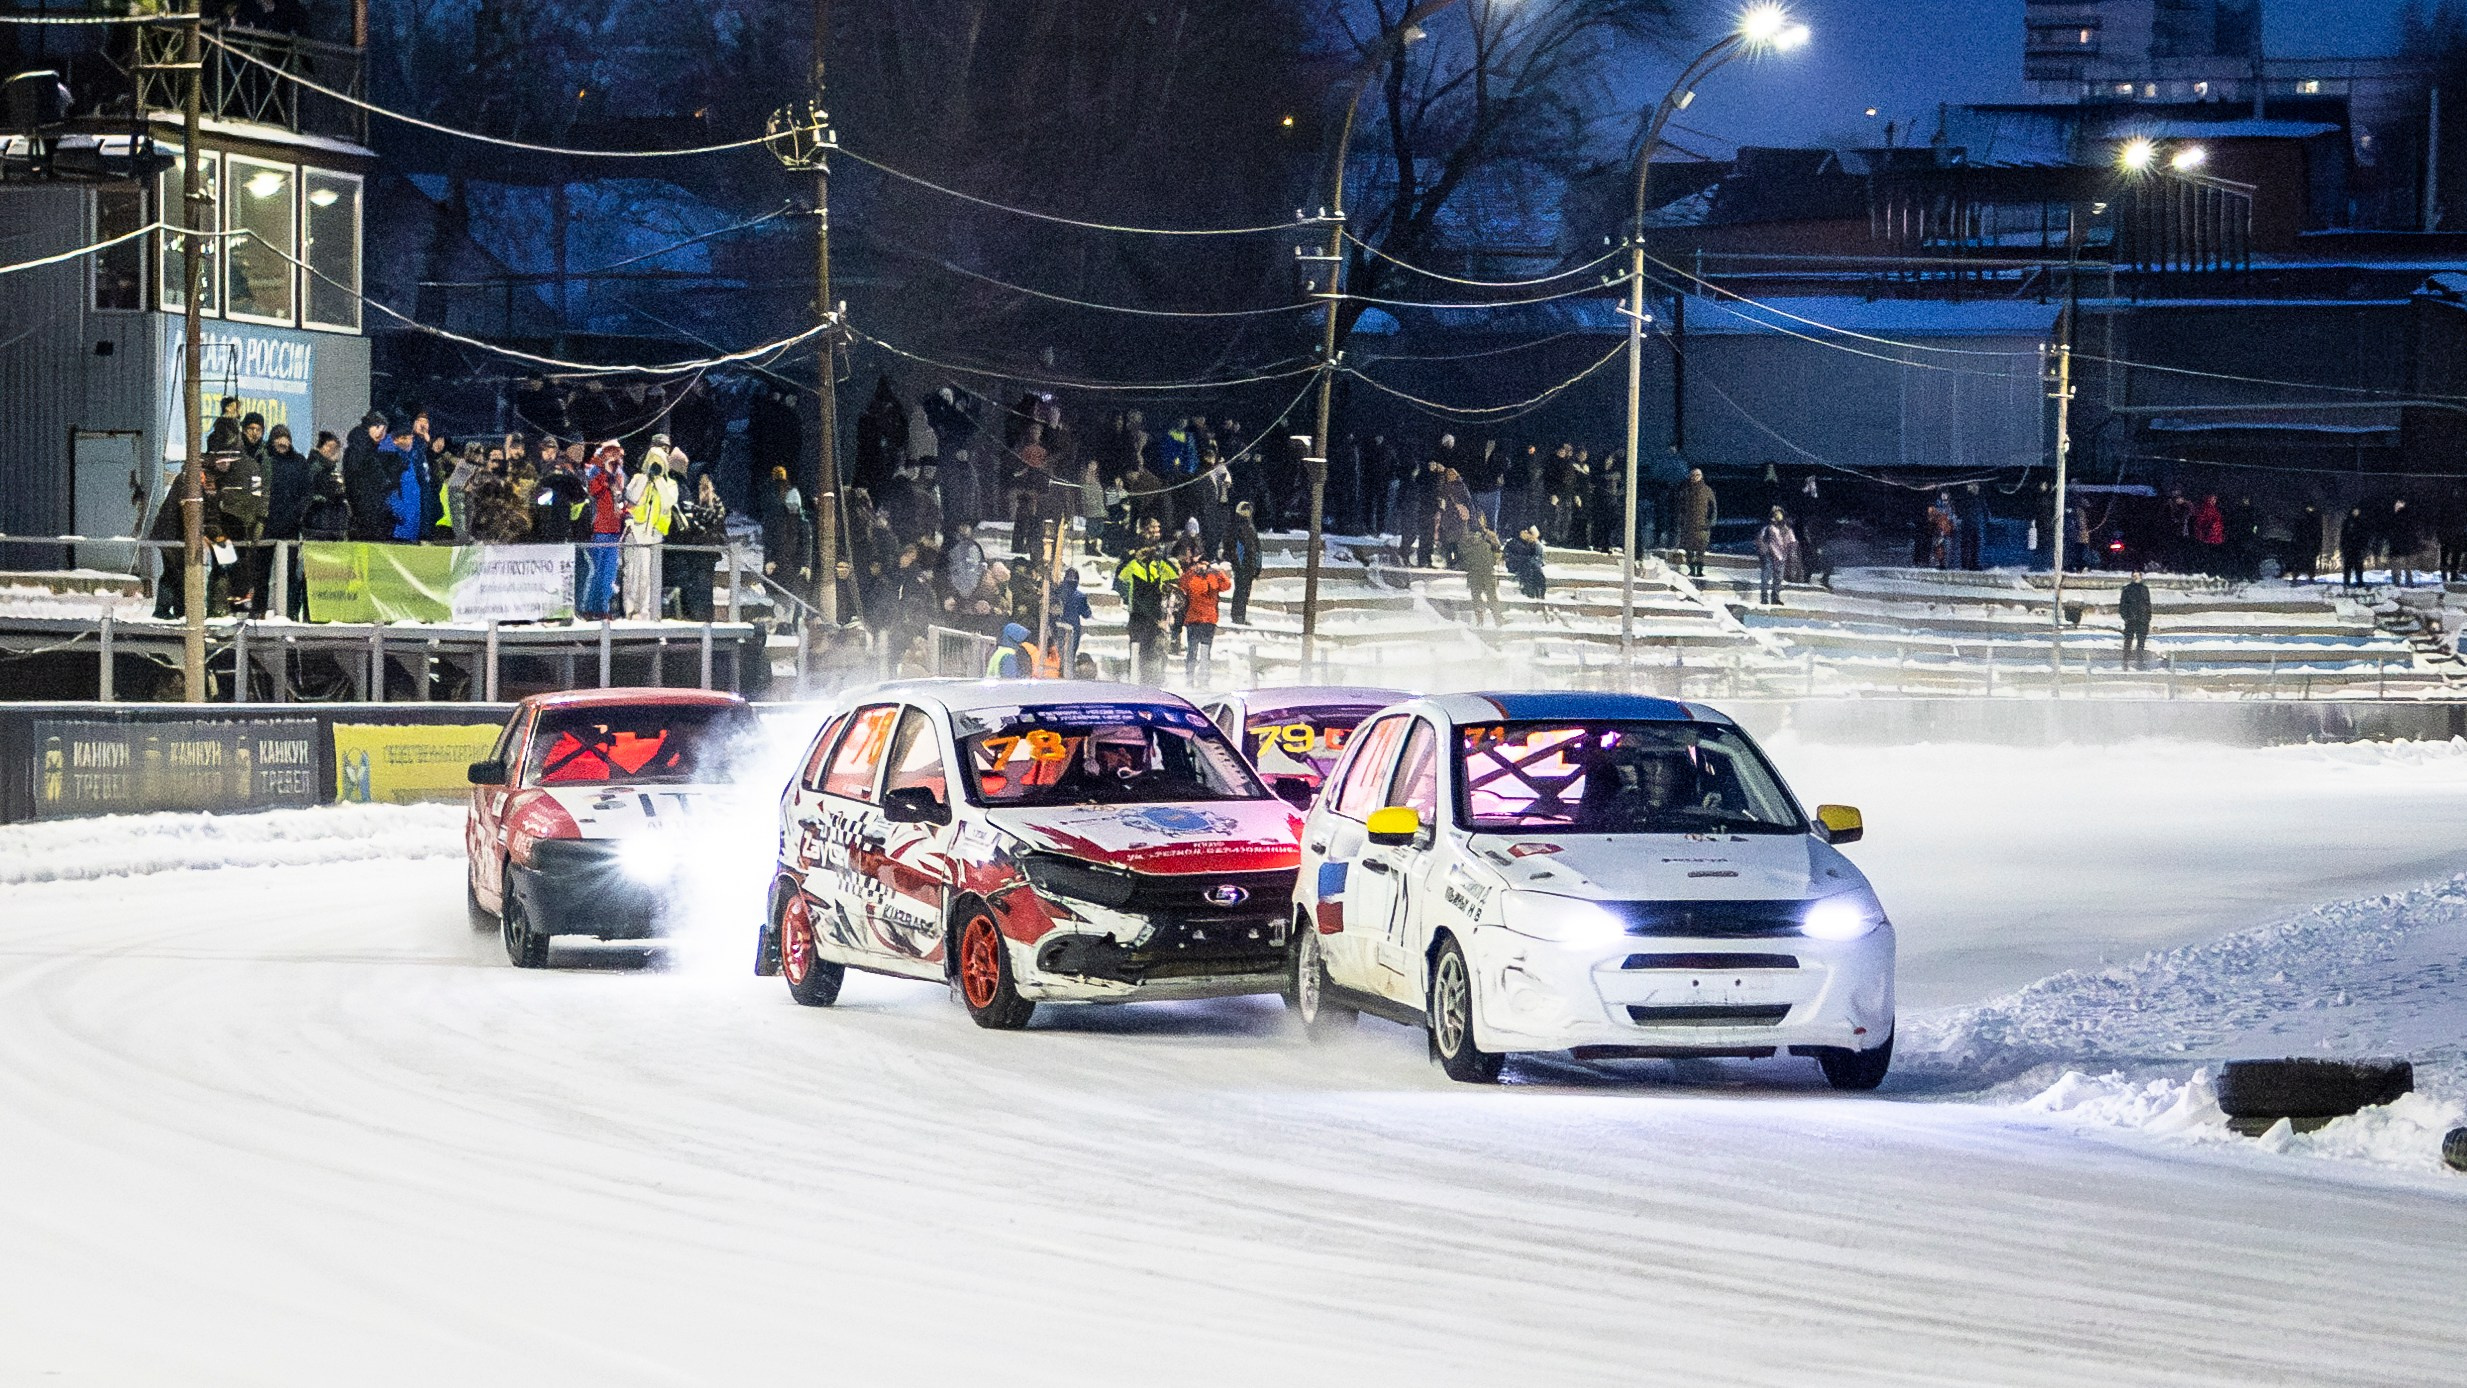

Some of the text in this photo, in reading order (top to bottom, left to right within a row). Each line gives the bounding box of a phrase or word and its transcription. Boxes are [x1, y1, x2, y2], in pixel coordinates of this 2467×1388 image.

[246, 337, 310, 379] РОССИИ
[74, 741, 130, 767] КАНКУН
[259, 740, 308, 764] КАНКУН
[981, 729, 1066, 771] 78
[1247, 721, 1315, 758] 79
